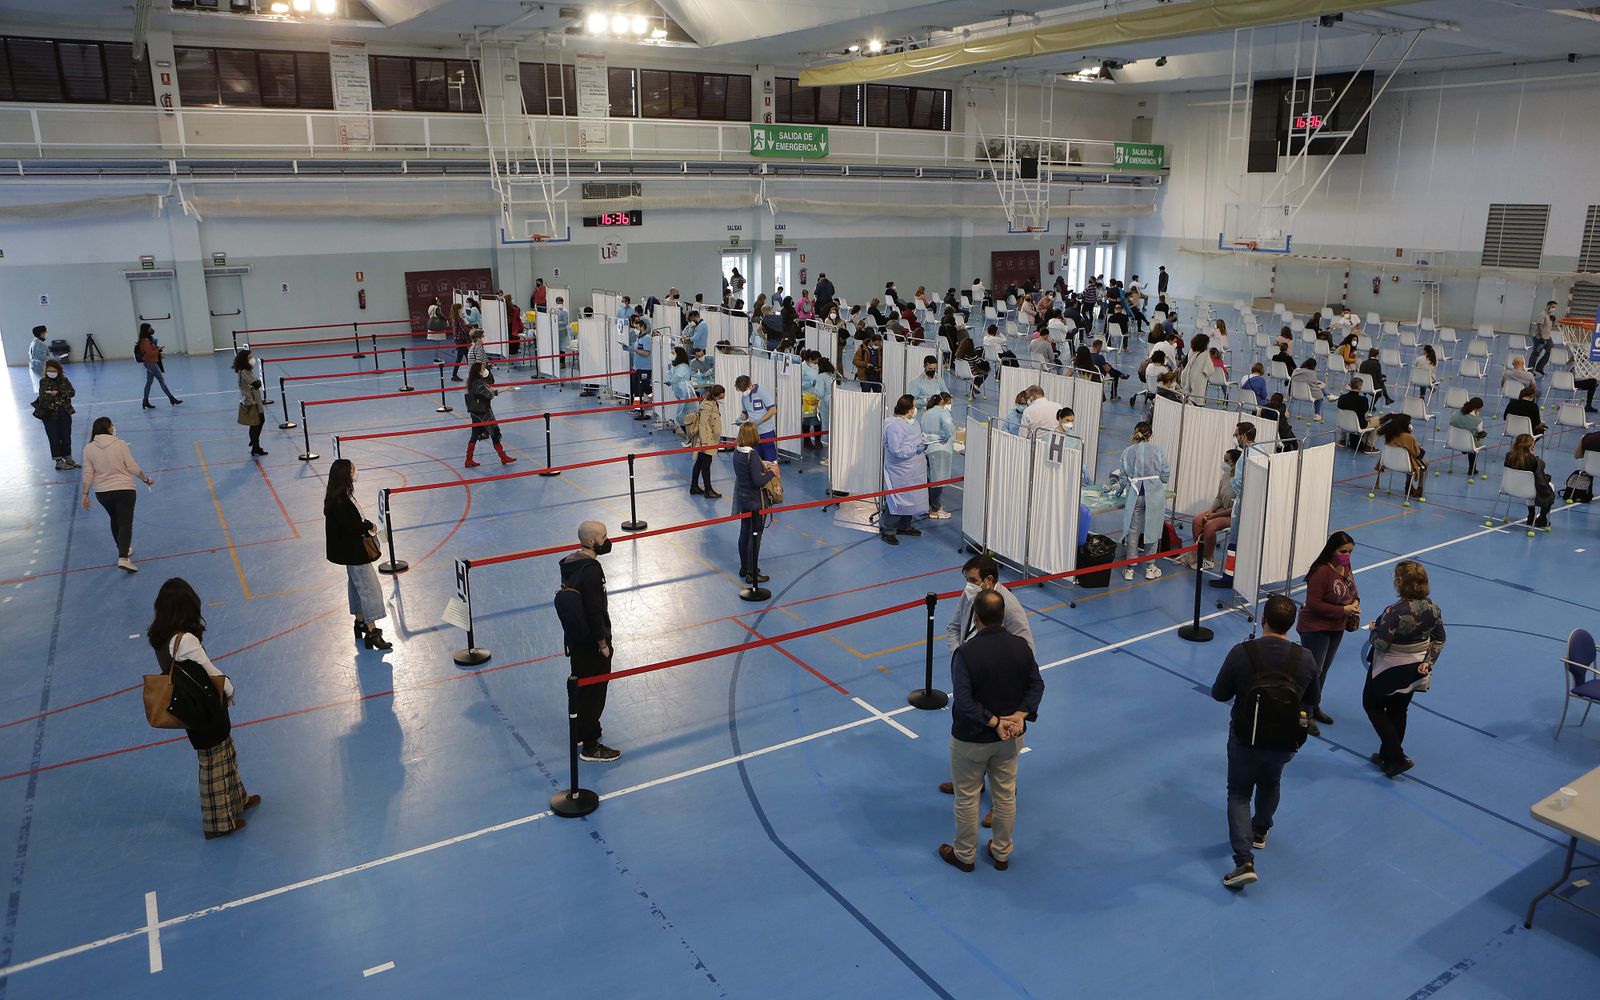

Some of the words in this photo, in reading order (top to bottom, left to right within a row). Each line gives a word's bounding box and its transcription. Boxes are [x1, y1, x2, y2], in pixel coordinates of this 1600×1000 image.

[778, 131, 802, 141] SALIDA
[803, 132, 813, 141] DE
[775, 142, 818, 152] EMERGENCIA
[1132, 148, 1148, 156] SALIDA
[1129, 157, 1157, 165] EMERGENCIA
[601, 212, 629, 225] 16:36
[1048, 433, 1065, 464] H
[454, 559, 467, 596] H
